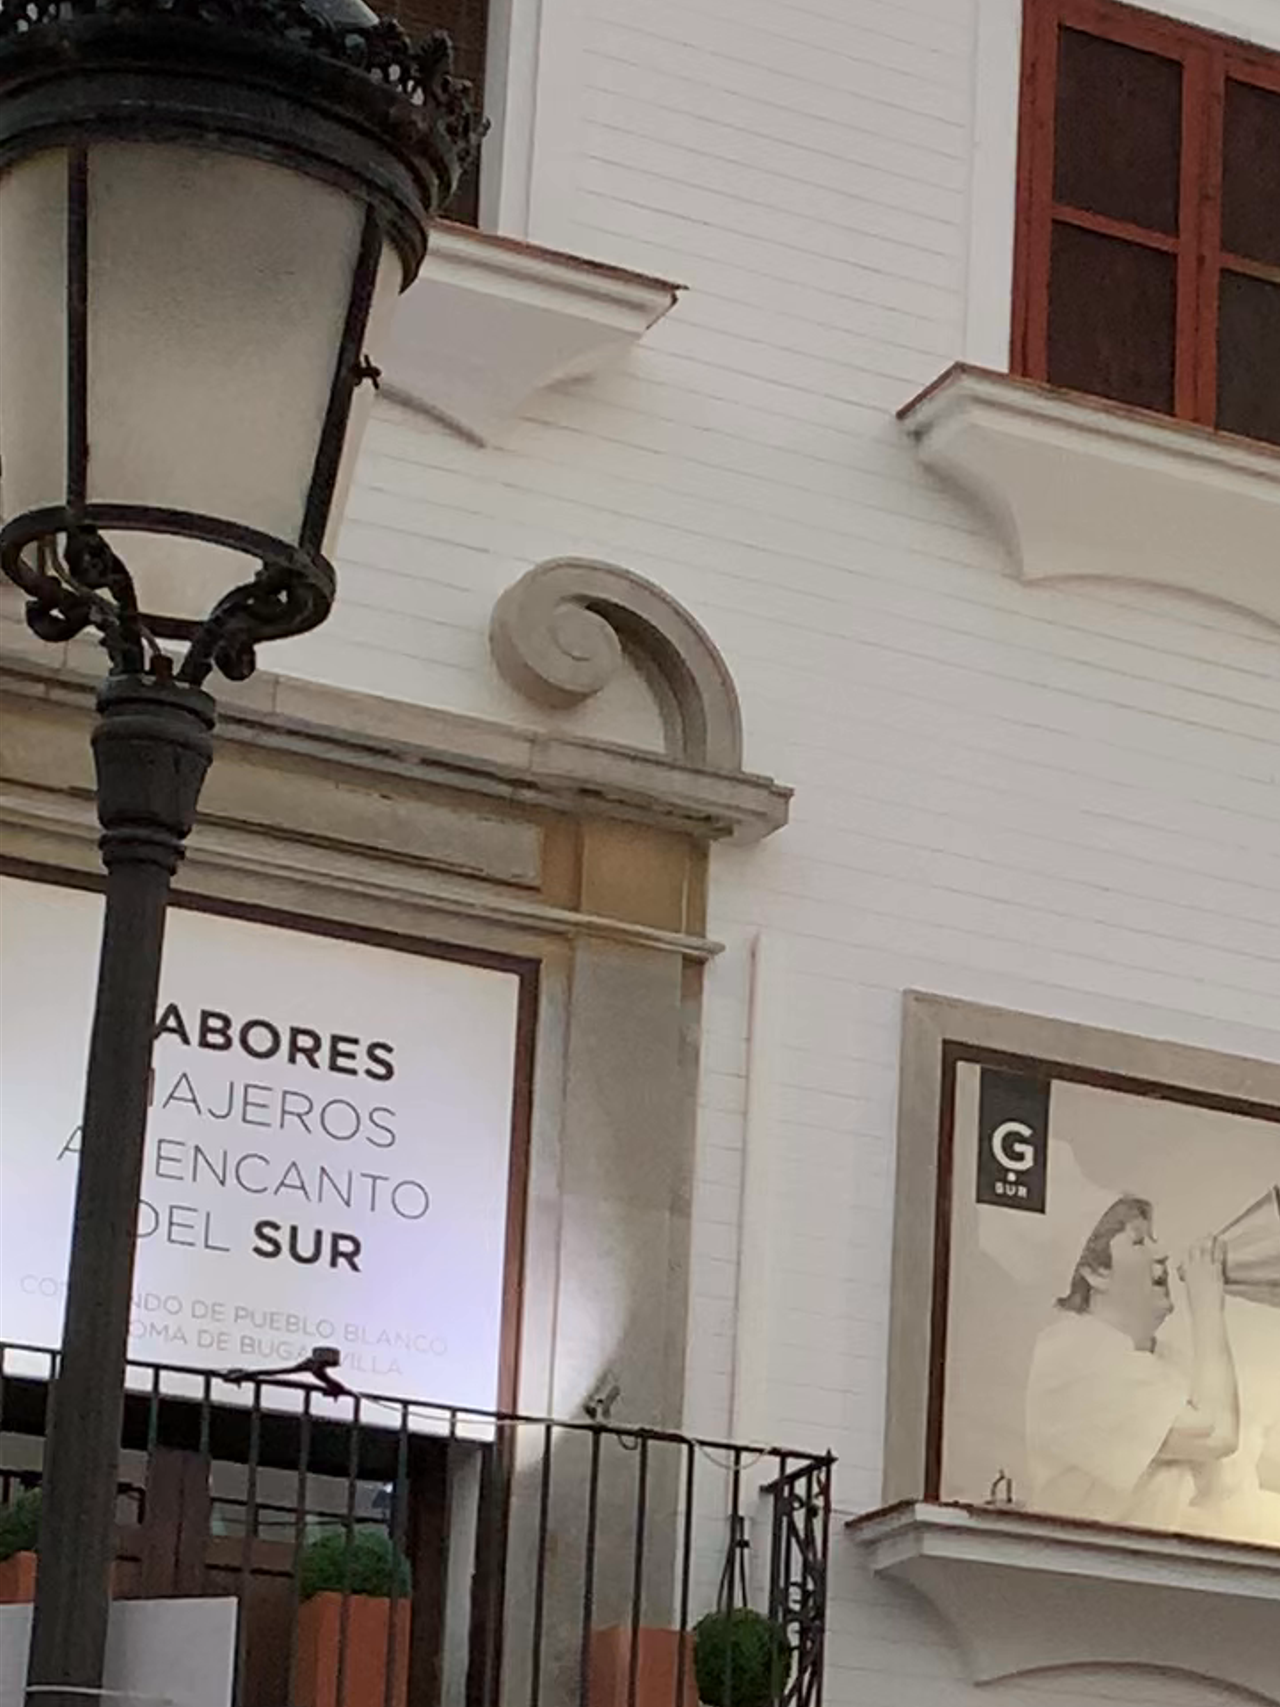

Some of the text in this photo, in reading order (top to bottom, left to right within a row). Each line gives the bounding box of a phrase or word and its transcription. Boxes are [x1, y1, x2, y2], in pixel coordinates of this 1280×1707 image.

[152, 1003, 396, 1082] ABORES
[992, 1121, 1034, 1171] G
[155, 1139, 430, 1220] ENCANTO
[137, 1198, 362, 1273] DEL SUR
[131, 1319, 188, 1345] OMA
[197, 1329, 230, 1351] DE
[191, 1299, 226, 1322] DE
[234, 1305, 335, 1339] PUEBLO
[344, 1323, 448, 1356] BLANCO
